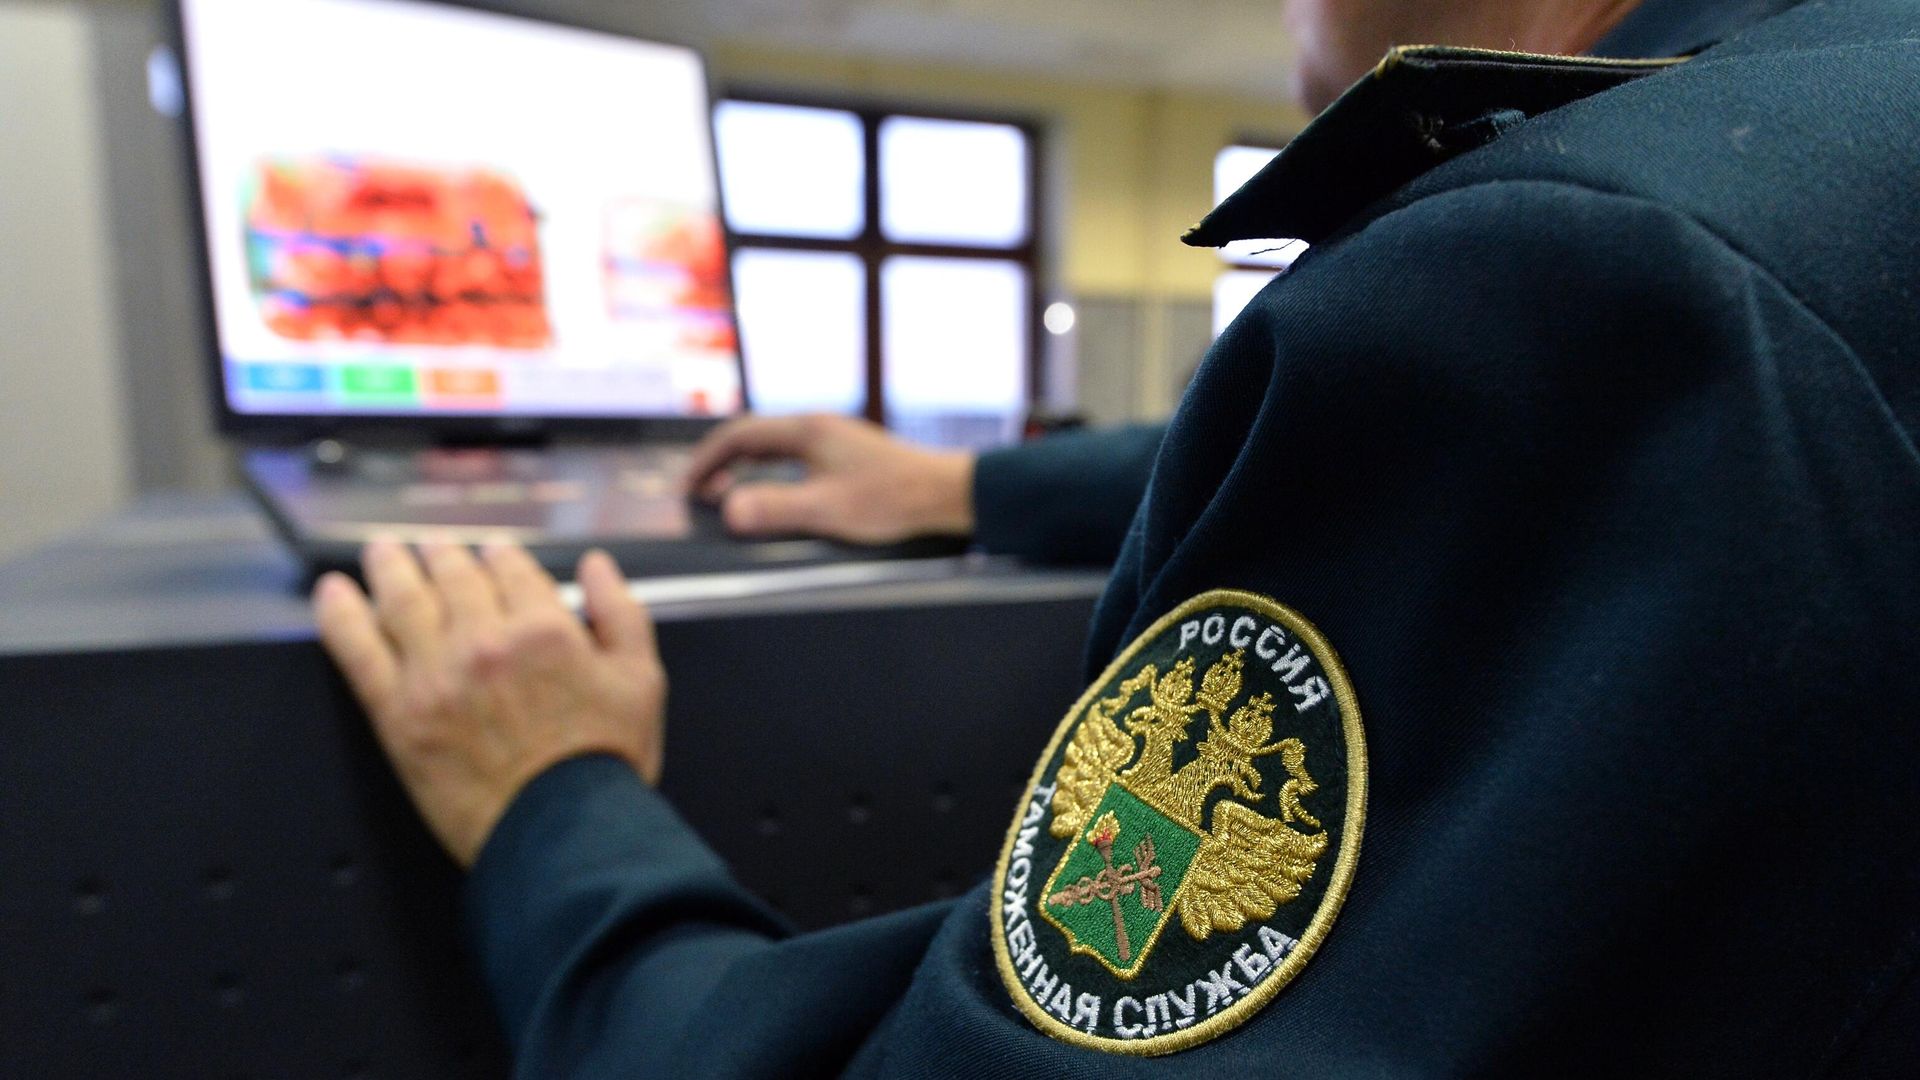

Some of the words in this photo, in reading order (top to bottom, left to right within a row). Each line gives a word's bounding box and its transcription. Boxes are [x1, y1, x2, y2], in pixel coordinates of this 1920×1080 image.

[1179, 614, 1330, 711] РОССИЯ
[1004, 782, 1100, 1035] ТАМОЖЕННАЯ
[1114, 925, 1298, 1038] СЛУЖБА
